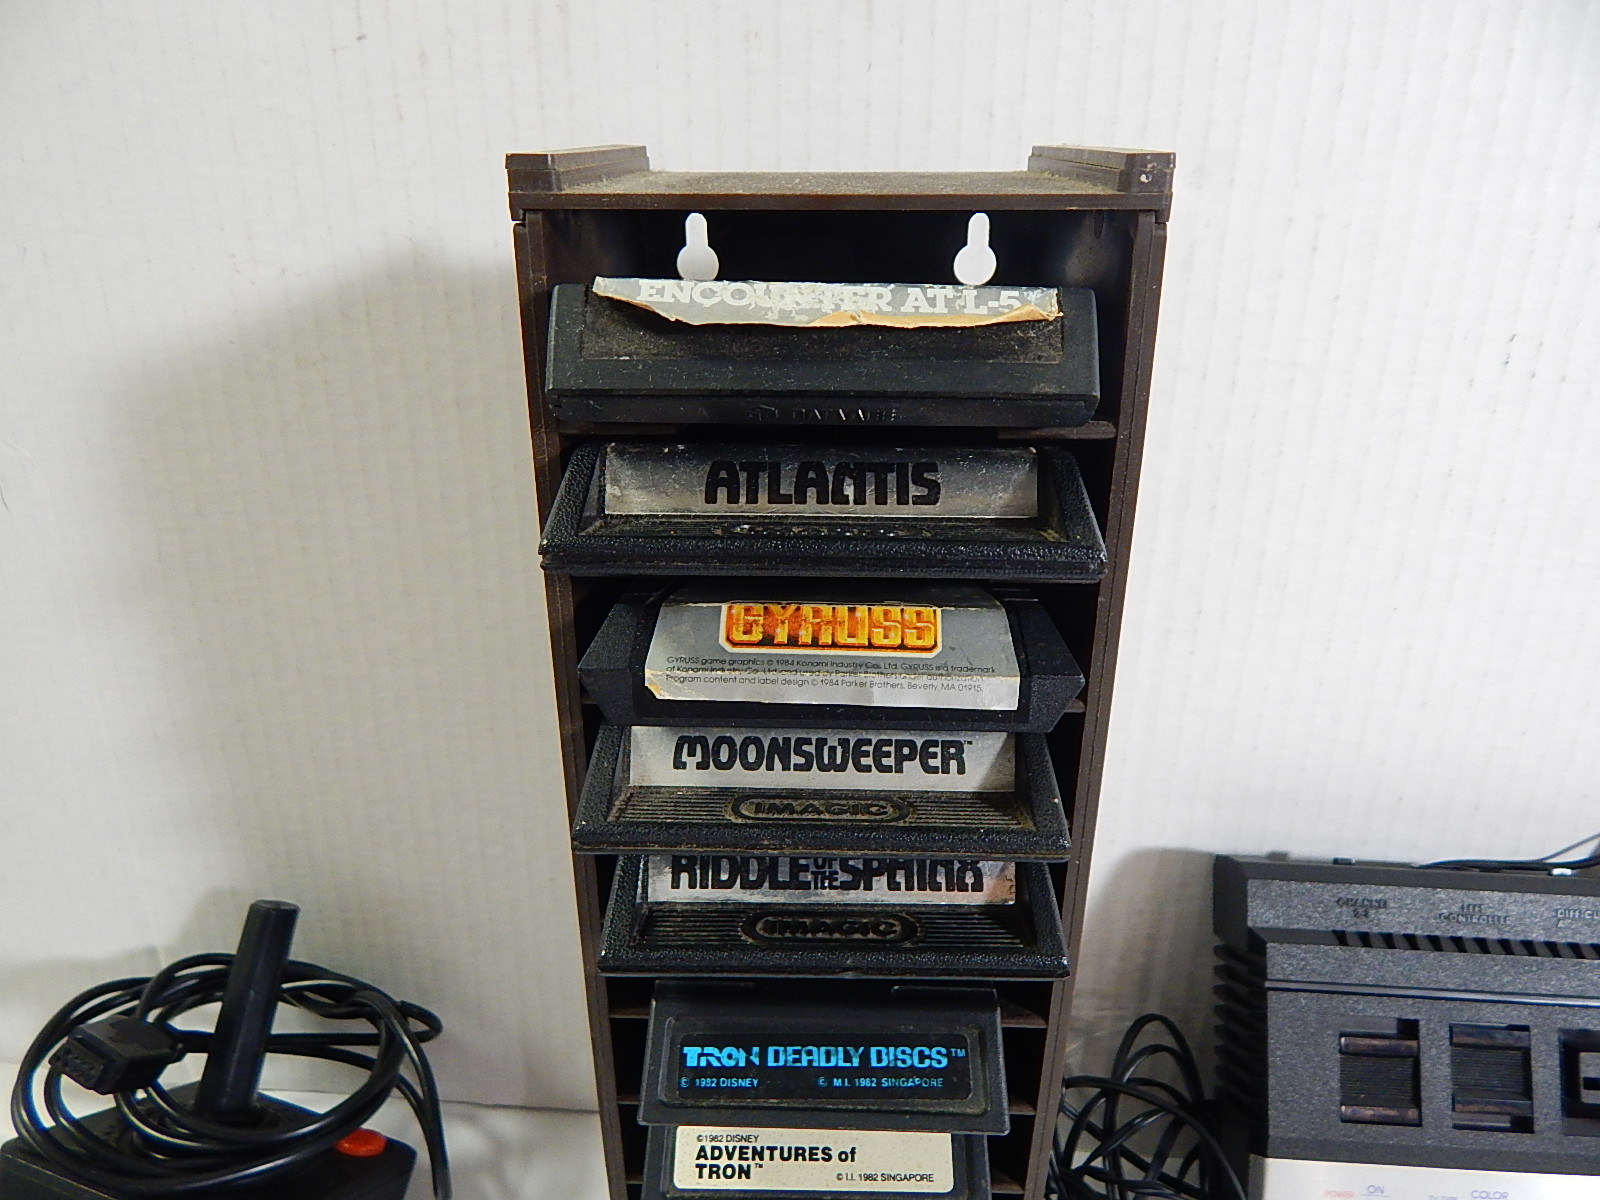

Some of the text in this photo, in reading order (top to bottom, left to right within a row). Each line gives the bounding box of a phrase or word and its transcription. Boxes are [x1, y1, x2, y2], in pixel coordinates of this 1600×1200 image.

[901, 288, 956, 314] AT
[963, 289, 1022, 315] L-5
[704, 460, 942, 506] ATLANTIS
[729, 603, 935, 647] GYRUSS
[667, 656, 699, 664] GYRUSS
[700, 657, 727, 666] game
[728, 657, 765, 667] graphics
[776, 659, 795, 667] 1984
[796, 660, 828, 668] Konami
[830, 660, 863, 670] Industry
[901, 662, 933, 671] GYRUSS
[951, 664, 996, 673] trademark
[666, 674, 701, 684] Program
[739, 676, 755, 684] and
[758, 677, 779, 685] label
[781, 678, 809, 687] design
[820, 678, 839, 686] 1984
[841, 679, 867, 688] Parker
[941, 683, 956, 691] MA
[673, 735, 966, 775] MOONSWEEPER
[754, 802, 889, 817] IMAGIC
[671, 855, 811, 890] RIDDLE
[683, 1046, 760, 1067] TRON
[767, 1046, 864, 1067] DEADLY
[870, 1046, 949, 1068] DISCS
[695, 1078, 717, 1087] 1982
[720, 1078, 759, 1088] DISNEY
[855, 1078, 877, 1087] 1982
[881, 1077, 943, 1088] SINGAPORE
[725, 1134, 759, 1143] DISNEY
[695, 1145, 856, 1162] ADVENTURES of
[695, 1163, 751, 1180] TRON
[858, 1173, 878, 1181] 1982
[880, 1173, 934, 1182] SINGAPORE
[1366, 1185, 1385, 1194] ON
[1471, 1190, 1509, 1200] COLOR
